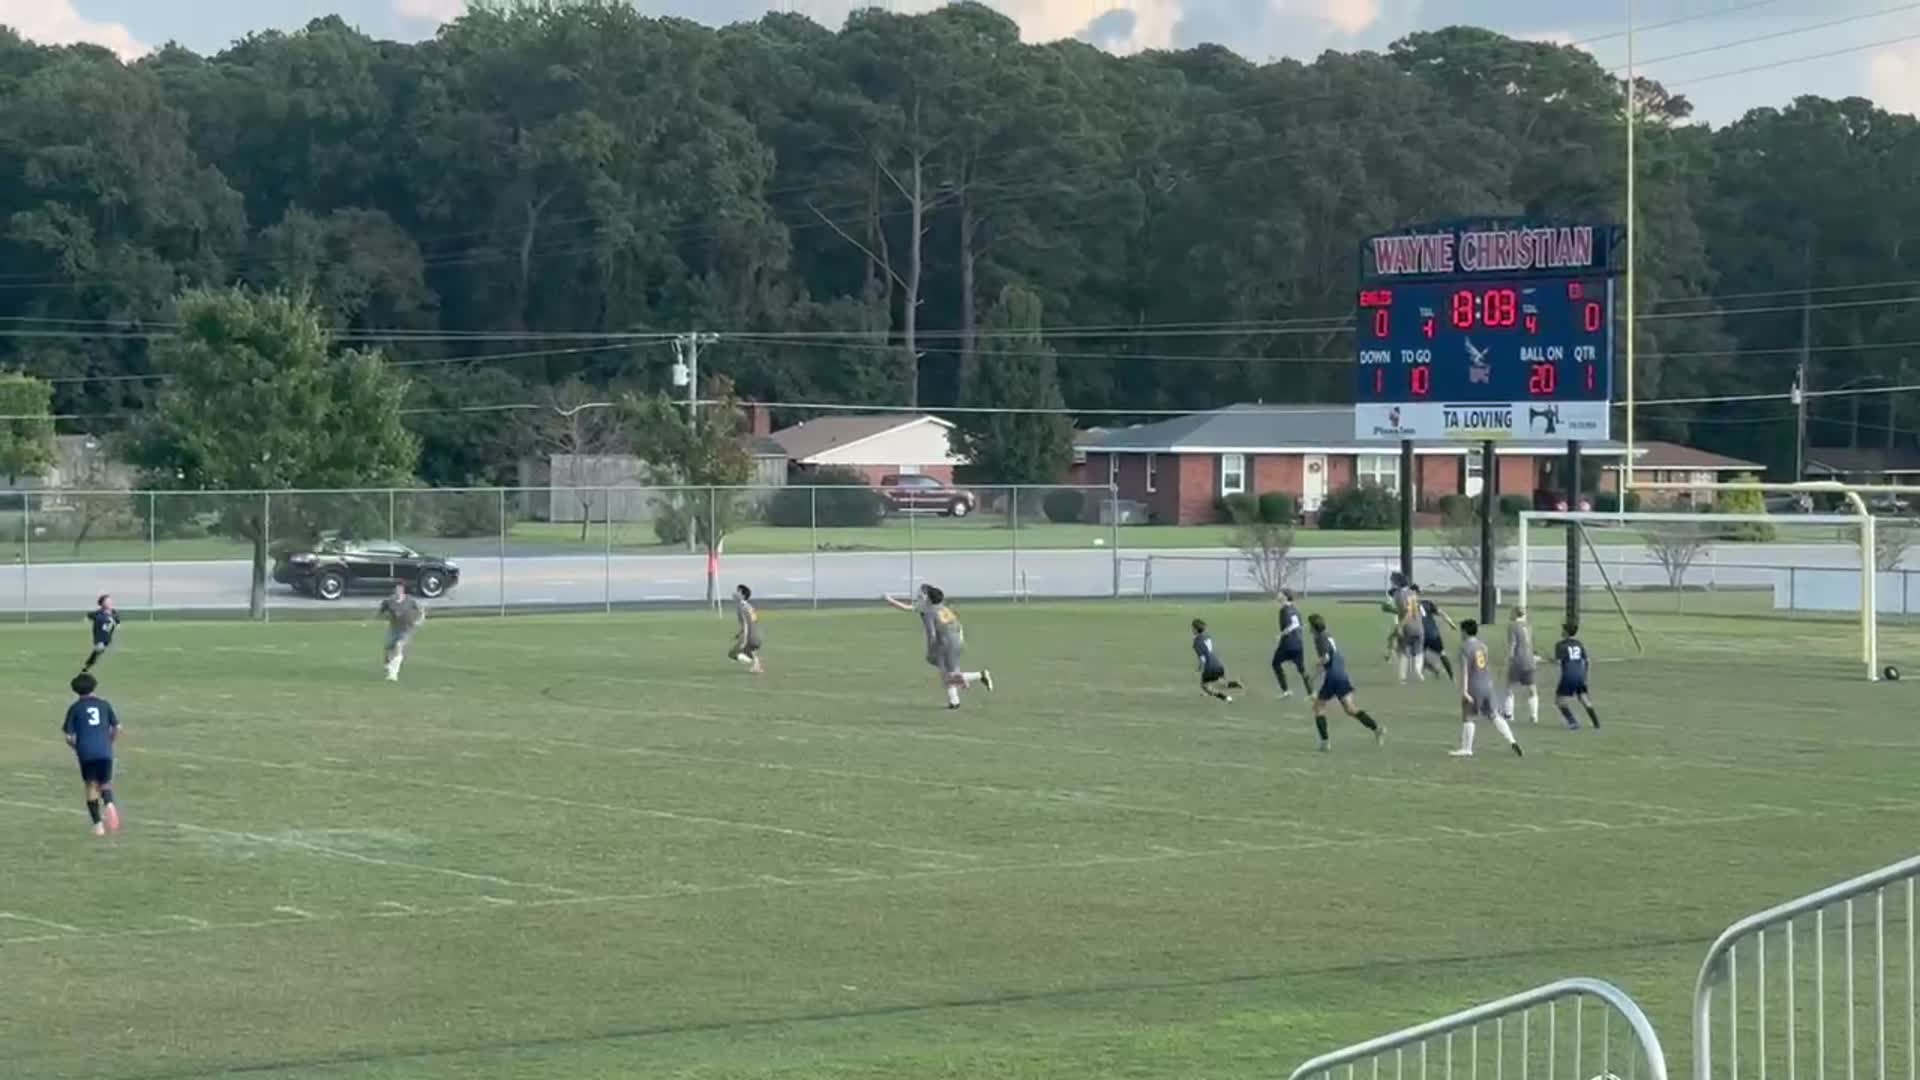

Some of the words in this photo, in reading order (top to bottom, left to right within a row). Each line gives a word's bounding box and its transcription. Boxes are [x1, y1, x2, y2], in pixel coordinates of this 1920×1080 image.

[1373, 238, 1453, 273] WAYNE
[1459, 227, 1593, 271] CHRISTIAN
[1376, 310, 1388, 337] 0
[1585, 303, 1599, 331] 0
[1360, 350, 1391, 364] DOWN
[1401, 349, 1414, 363] TO
[1416, 349, 1431, 363] GO
[1520, 347, 1545, 361] BALL
[1547, 346, 1564, 360] ON
[1574, 345, 1596, 362] QTR
[1411, 367, 1429, 394] 10
[1529, 364, 1554, 393] 20
[1443, 411, 1459, 428] TA
[1464, 411, 1512, 428] LOVING
[1567, 646, 1581, 660] 12
[86, 706, 100, 726] 3
